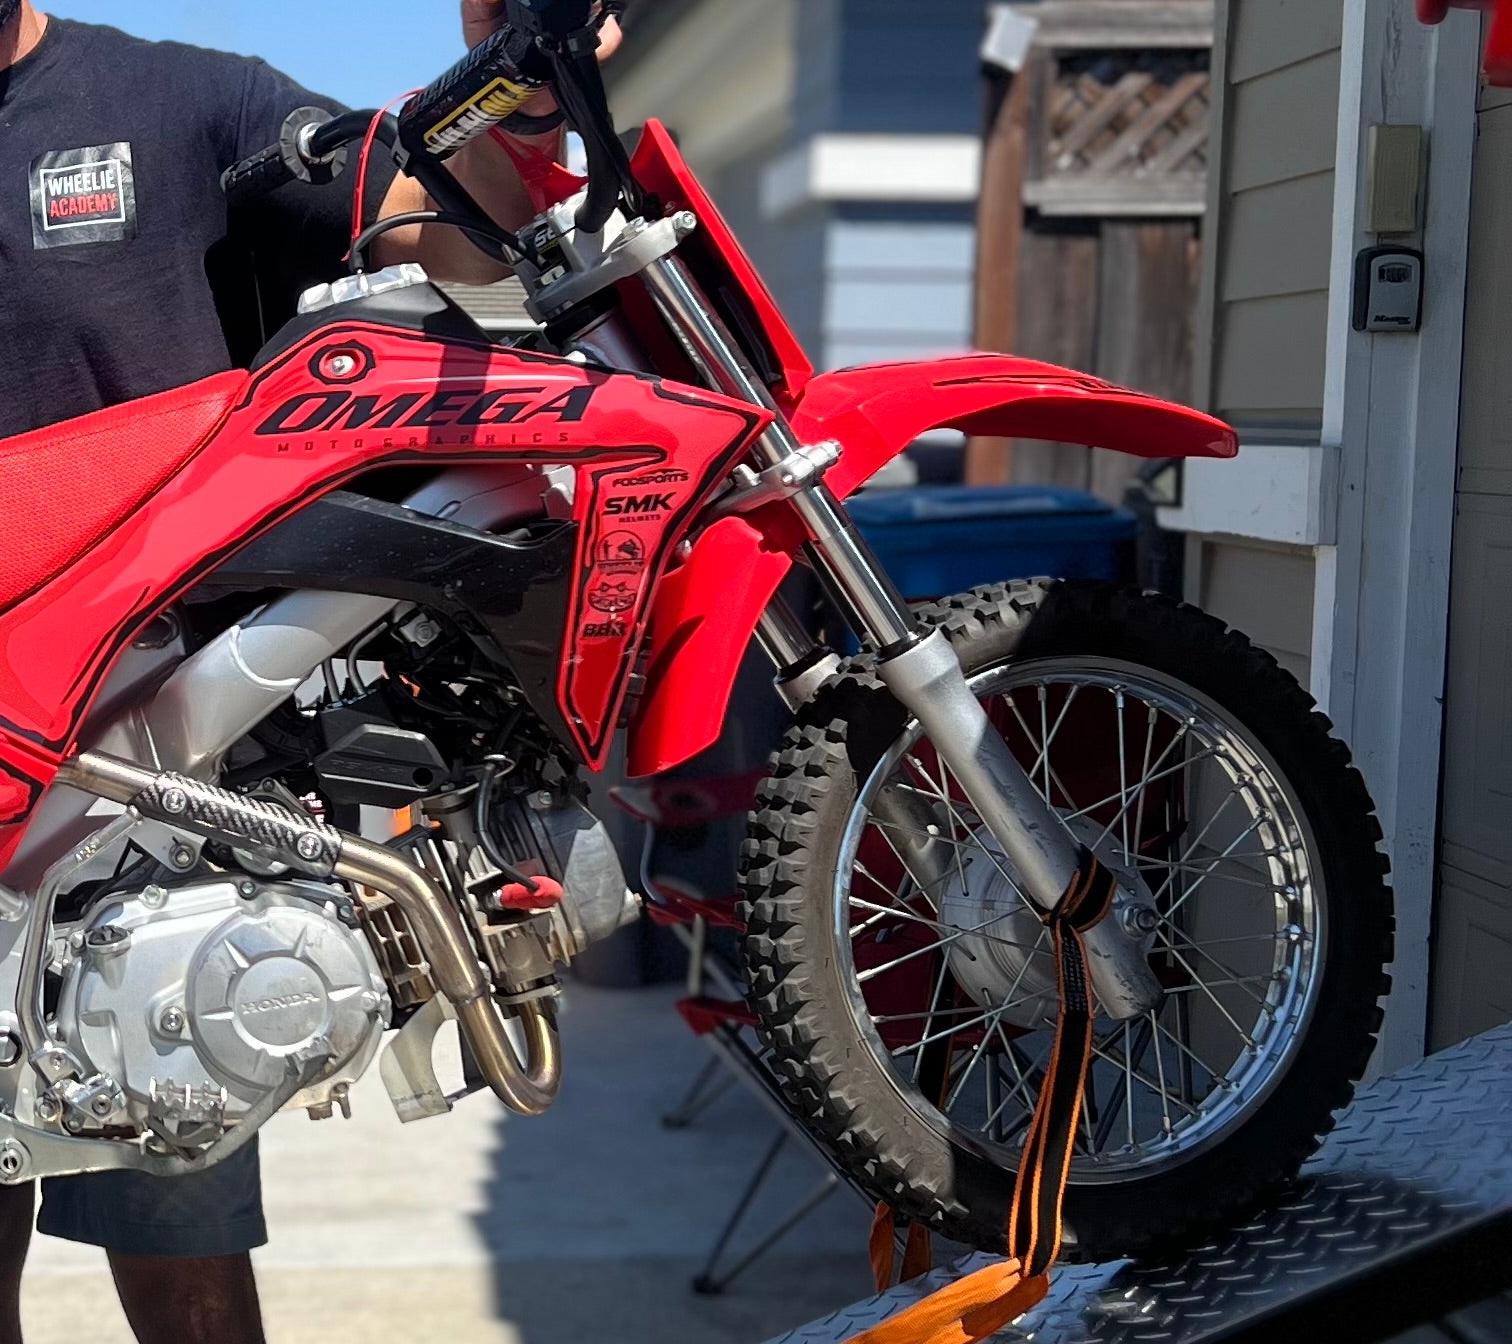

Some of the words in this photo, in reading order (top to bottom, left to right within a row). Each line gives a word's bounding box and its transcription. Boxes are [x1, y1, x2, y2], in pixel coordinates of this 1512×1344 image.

[48, 170, 116, 196] WHEELIE
[50, 193, 117, 217] ACADEMY
[254, 385, 597, 435] OMEGA
[278, 432, 569, 452] MOTOGRAPHICS
[602, 492, 676, 515] SMK
[241, 992, 321, 1015] HONDA
